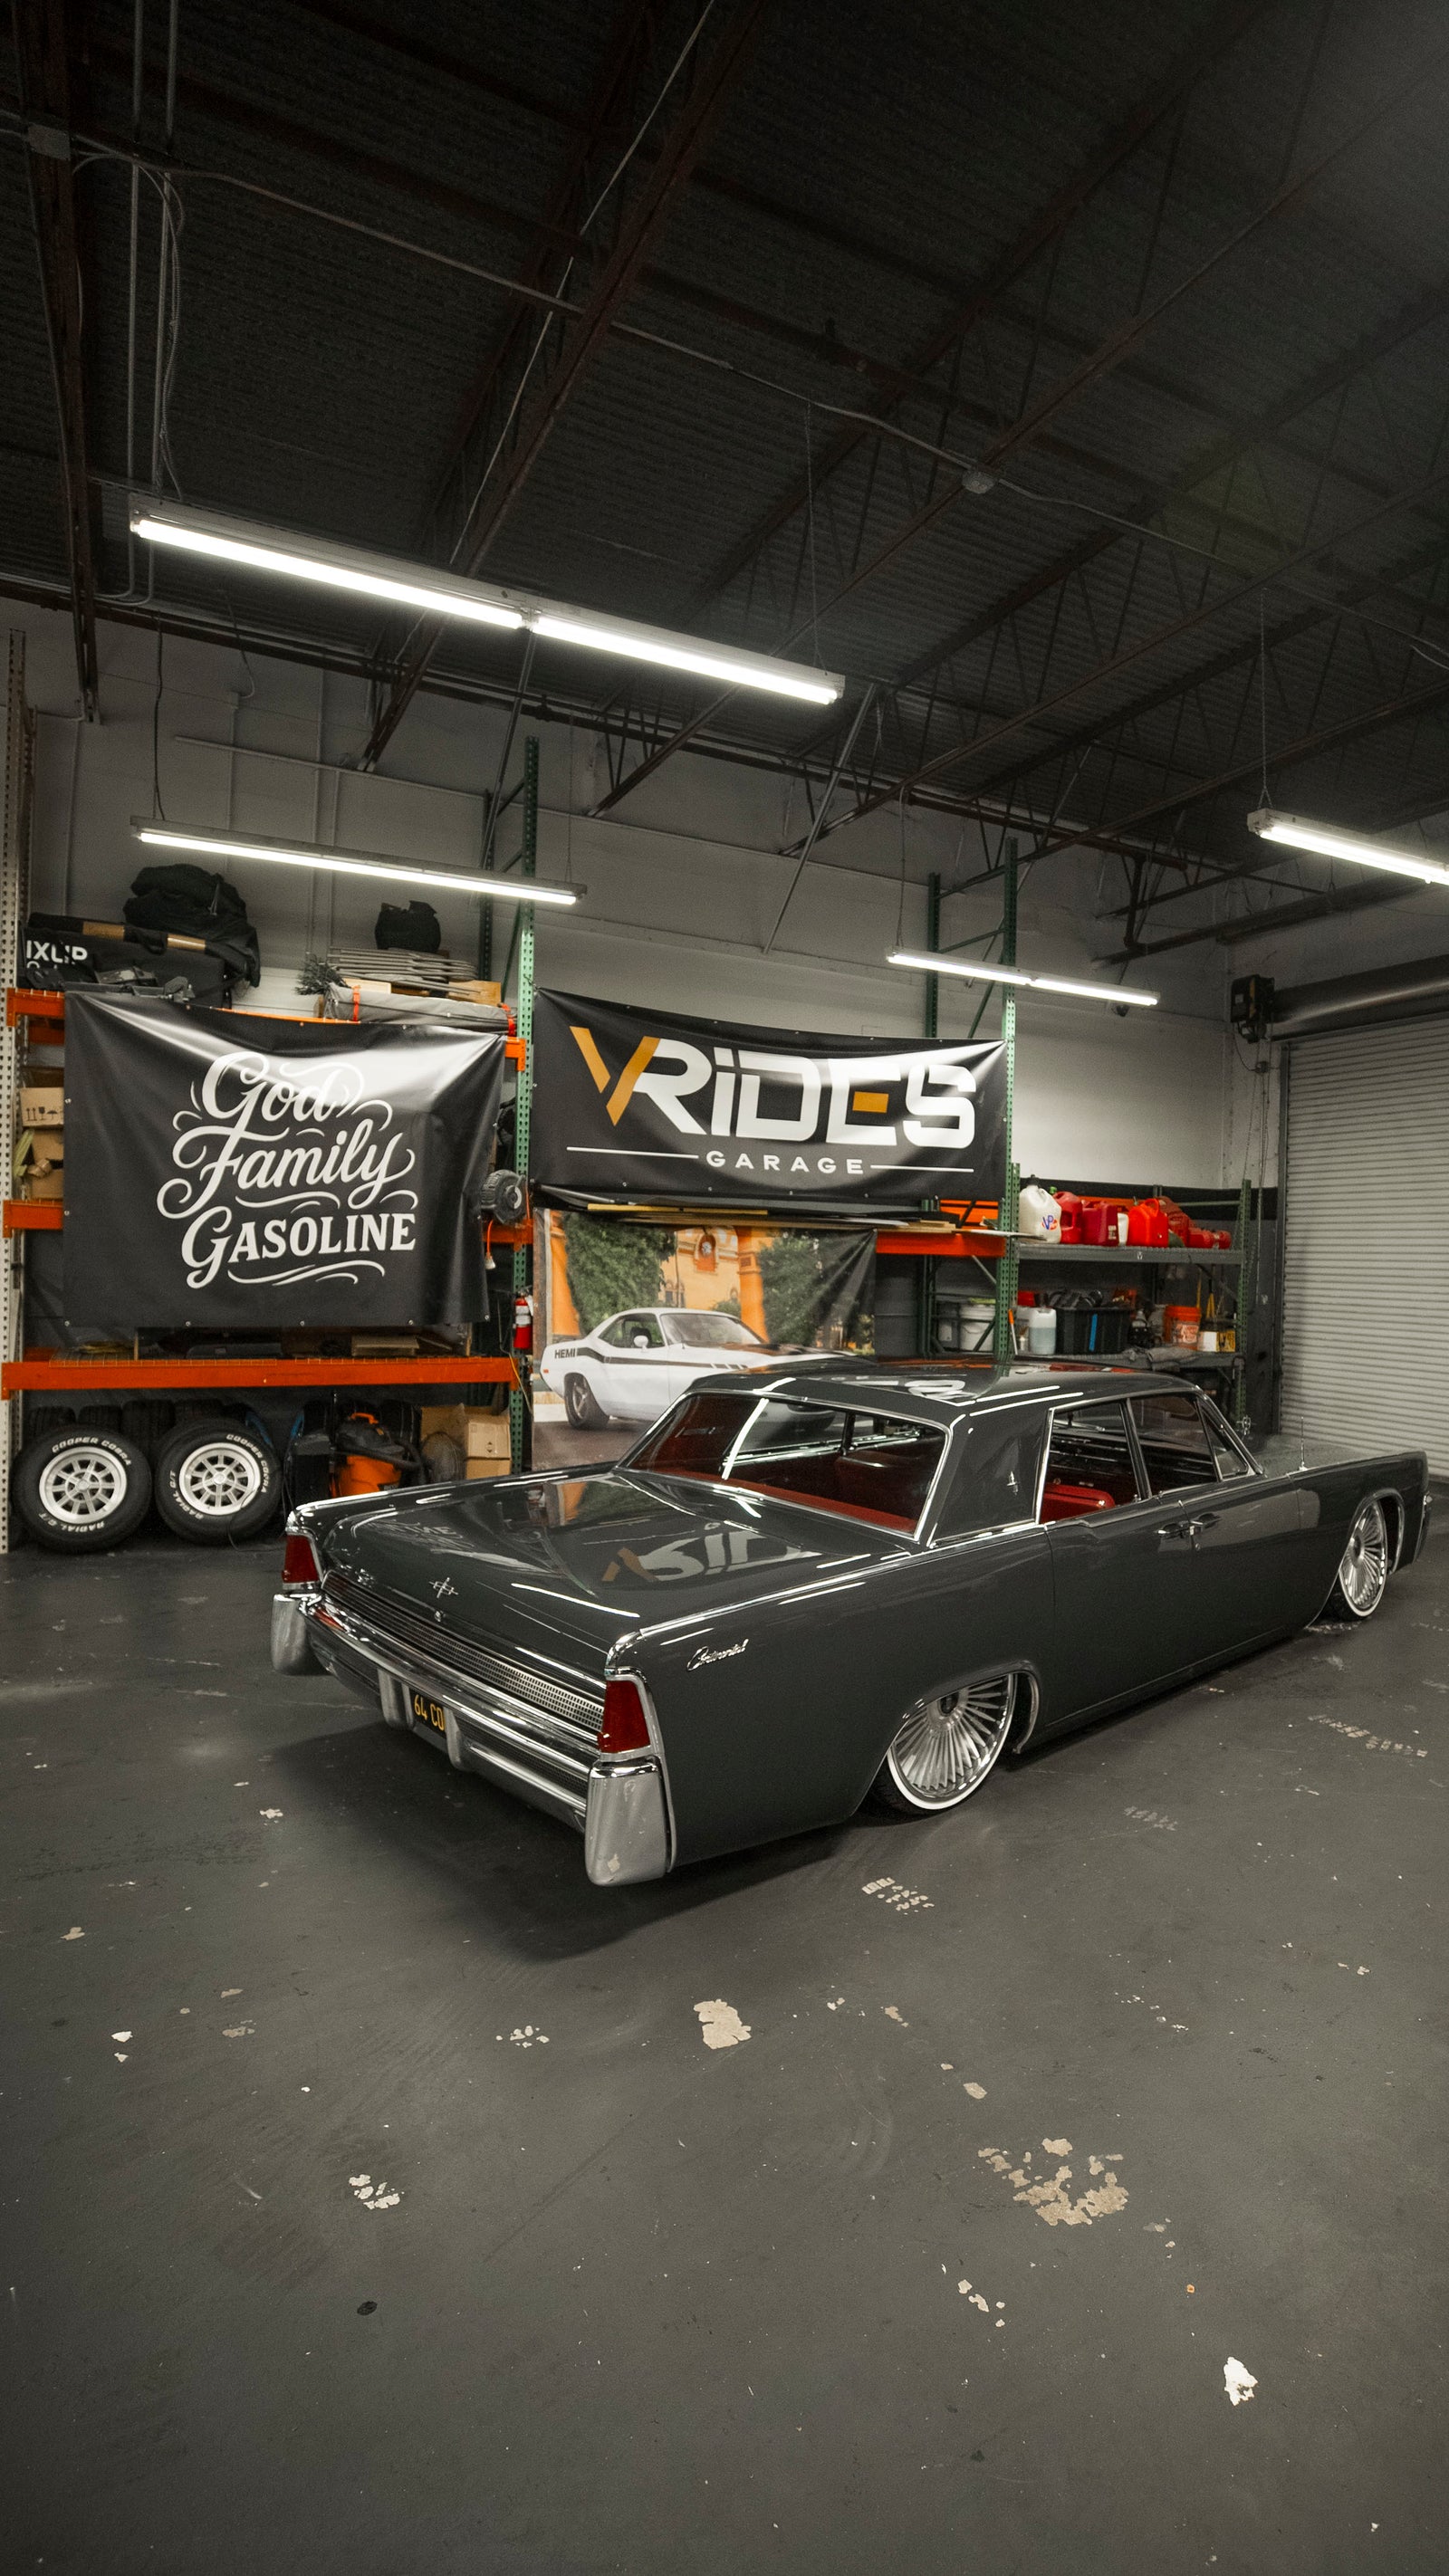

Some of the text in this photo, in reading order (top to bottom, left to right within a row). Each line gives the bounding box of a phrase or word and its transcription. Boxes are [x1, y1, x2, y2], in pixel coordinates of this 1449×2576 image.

[201, 1051, 365, 1122] God
[156, 1118, 416, 1220] Family
[705, 1150, 864, 1174] GARAGE
[181, 1206, 417, 1288] GASOLINE
[554, 1347, 576, 1359] HEMI
[52, 1437, 132, 1466] COOPER COBRA
[226, 1433, 270, 1493] COOPER COBRA
[61, 1521, 105, 1533] RADIAL
[414, 1694, 427, 1720] 64
